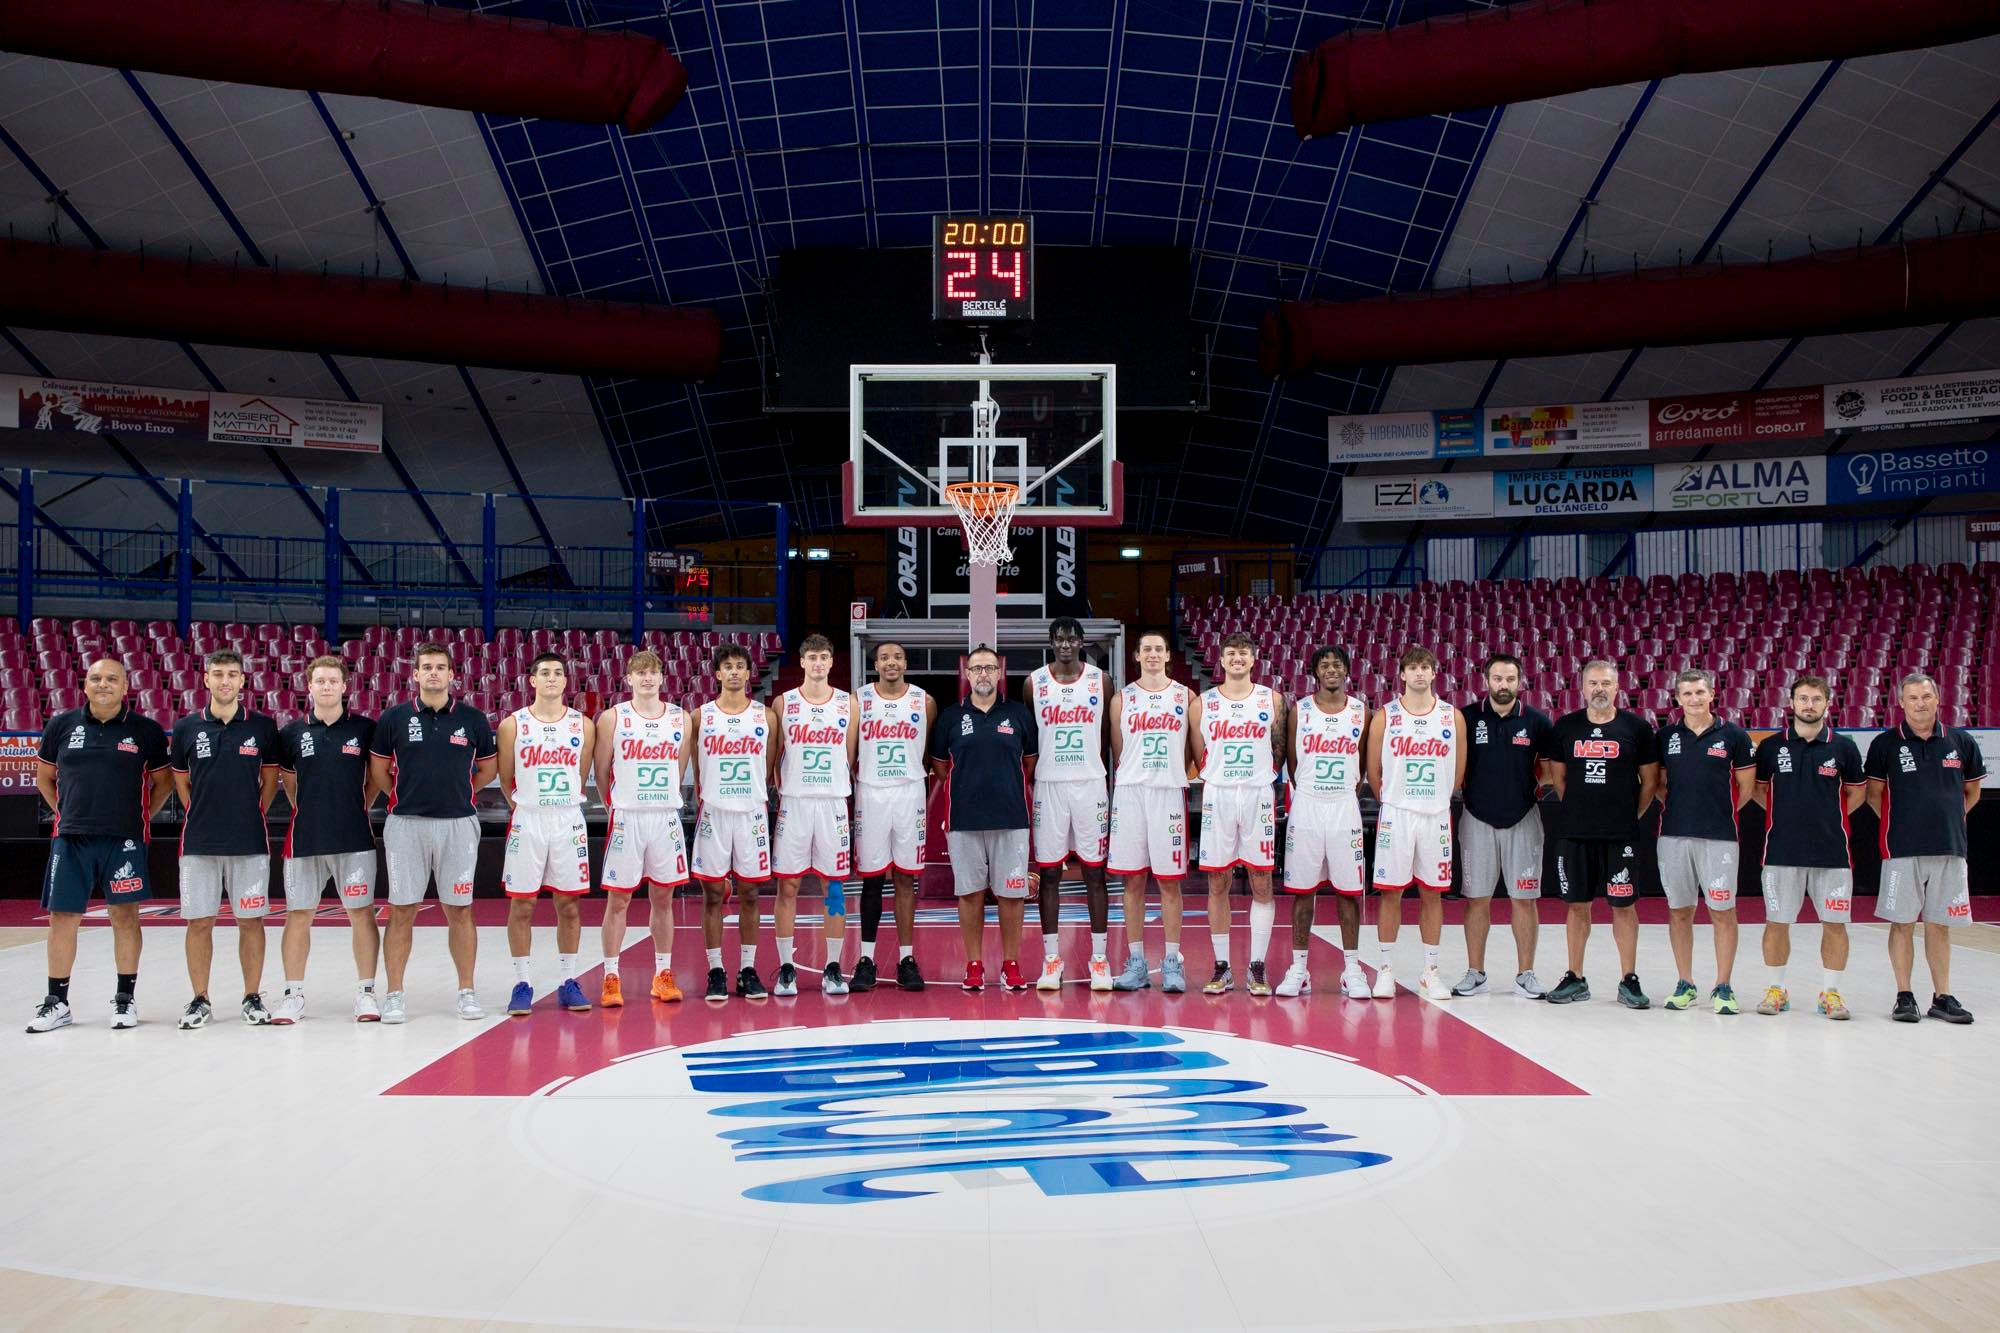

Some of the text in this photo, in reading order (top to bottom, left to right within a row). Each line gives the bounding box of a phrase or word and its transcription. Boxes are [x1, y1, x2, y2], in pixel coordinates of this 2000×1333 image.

[945, 223, 1024, 246] 20:00
[947, 252, 1021, 298] 24
[1880, 386, 1912, 394] LEADER
[1880, 392, 1918, 403] FOOD
[1922, 390, 1931, 400] &
[1929, 396, 1972, 406] PROVINCE
[214, 410, 280, 422] MASIERO
[1884, 407, 1919, 416] VENEZIA
[111, 419, 142, 431] Bovo
[145, 422, 175, 433] Enzo
[213, 420, 267, 431] MATTIA
[1370, 423, 1428, 440] HIBERNATUS
[1656, 424, 1742, 440] arredamenti
[1755, 422, 1806, 434] CORO.IT
[214, 433, 271, 443] COSTRUZIONI
[1881, 448, 1988, 472] Bassetto
[1509, 469, 1634, 482] IMPRESE FUNEBRI
[1705, 460, 1810, 490] ALMA
[1508, 480, 1638, 506] LUCARDA
[1535, 503, 1608, 513] DELL'ANGELO
[649, 557, 677, 568] SETTORE
[1178, 556, 1221, 575] SETTORE 1
[707, 715, 714, 725] 2
[1041, 705, 1095, 727] Mestre
[1128, 712, 1182, 733] Mestre
[522, 724, 529, 735] 3
[788, 724, 844, 744] Mestre
[861, 720, 918, 741] Mestre
[1208, 720, 1266, 741] Mestre
[703, 735, 763, 756] Mestre
[1302, 733, 1357, 754] Mestre
[1390, 736, 1450, 757] Mestre
[520, 744, 577, 768] Mestre
[1054, 754, 1085, 763] GEMINI
[719, 787, 752, 795] GEMINI
[1404, 788, 1435, 796] GEMINI
[676, 854, 686, 874] 0
[759, 851, 768, 870] 2
[1173, 850, 1181, 869] 4
[579, 863, 588, 882] 3
